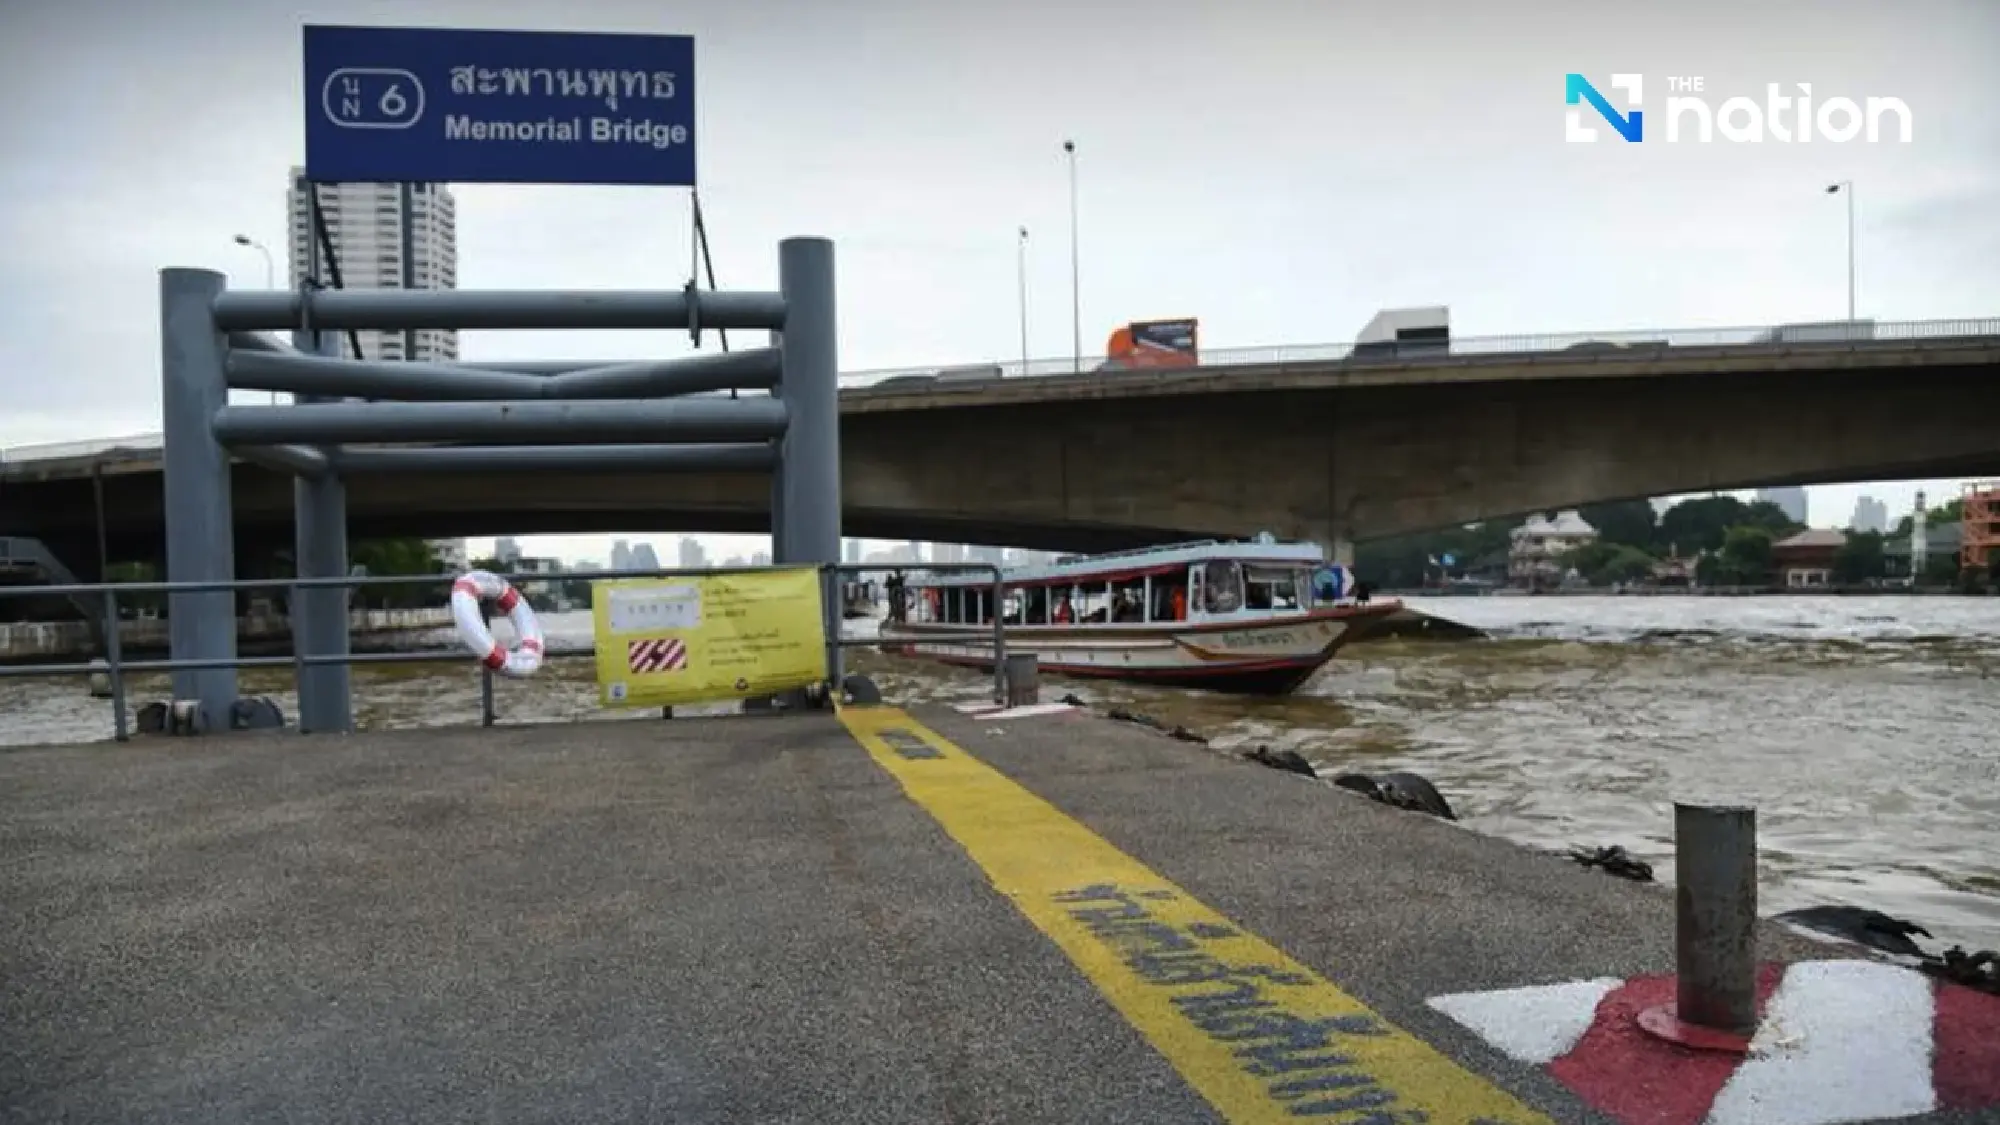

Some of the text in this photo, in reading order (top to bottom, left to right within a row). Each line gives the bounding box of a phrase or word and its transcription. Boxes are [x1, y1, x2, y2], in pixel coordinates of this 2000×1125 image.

[381, 84, 407, 116] 6
[449, 65, 678, 112] สะพานพุทธ
[342, 97, 360, 118] N
[445, 114, 687, 150] Memorial Bridge
